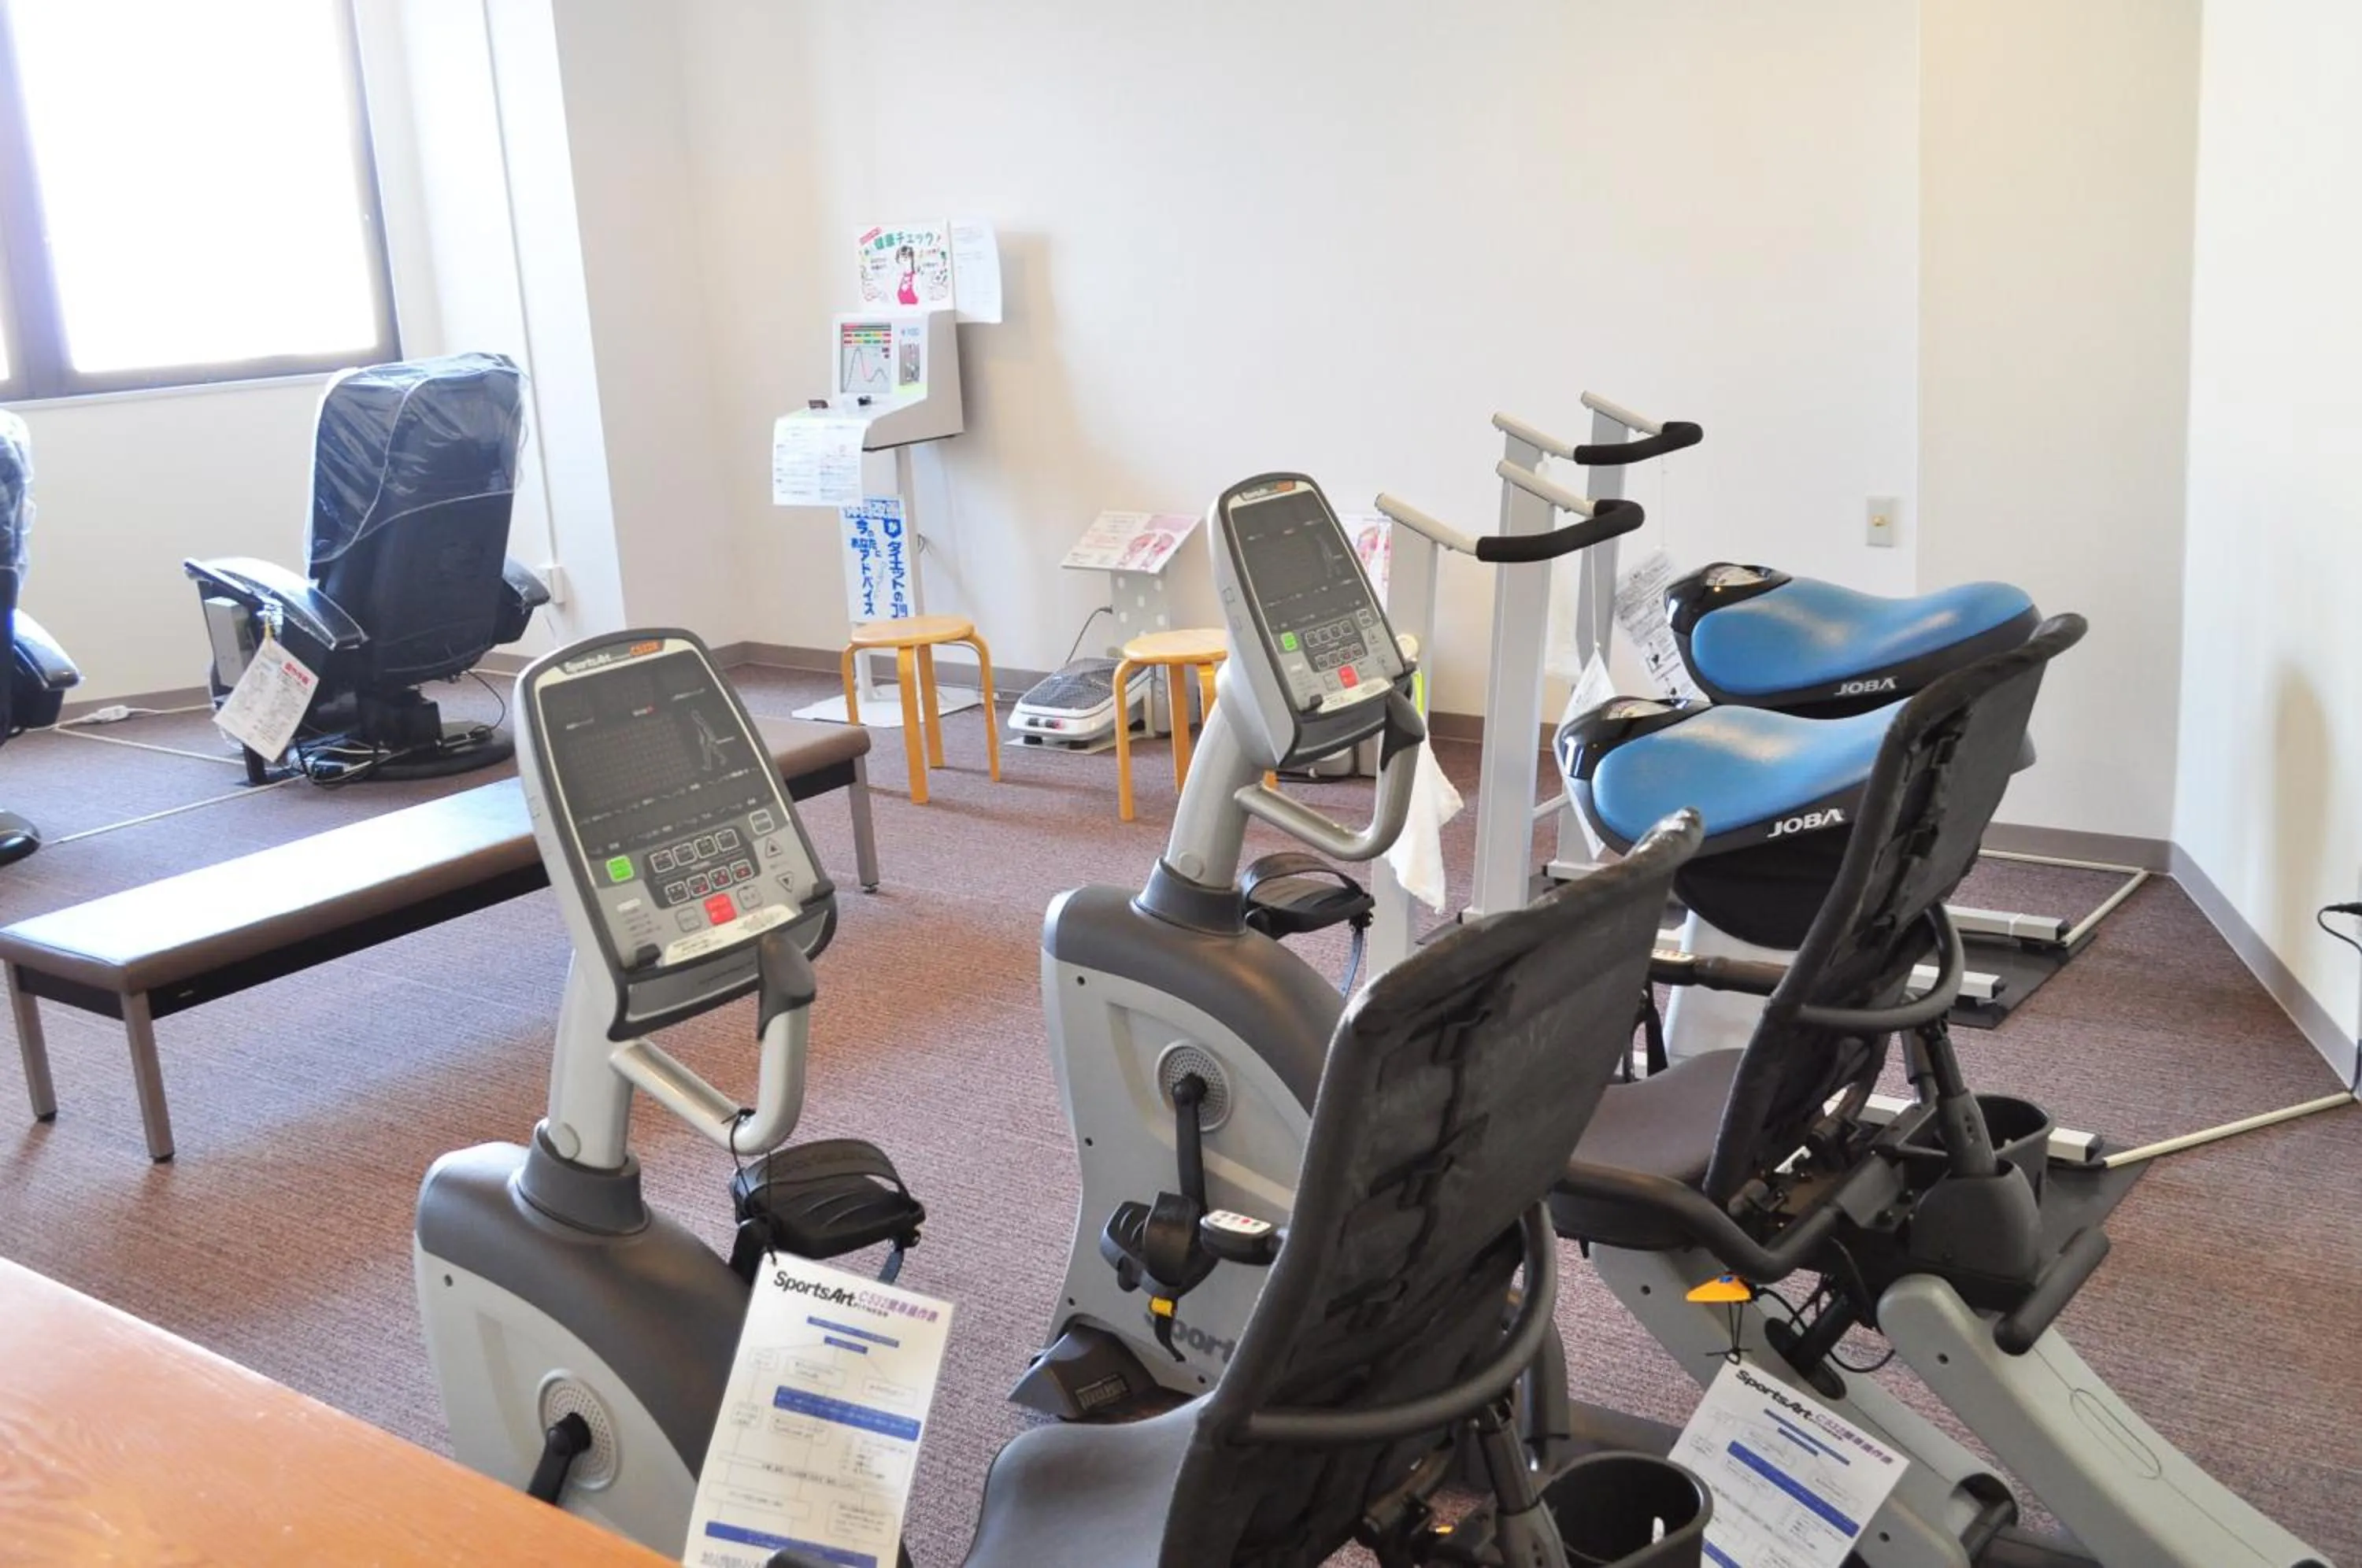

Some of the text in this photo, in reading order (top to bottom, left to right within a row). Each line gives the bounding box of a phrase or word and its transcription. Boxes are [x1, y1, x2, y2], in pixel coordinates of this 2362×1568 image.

[1834, 675, 1898, 696] JOBA
[1766, 808, 1845, 838] JOBA
[773, 1270, 855, 1308] SportsArt
[1735, 1370, 1813, 1420] SportsArt
